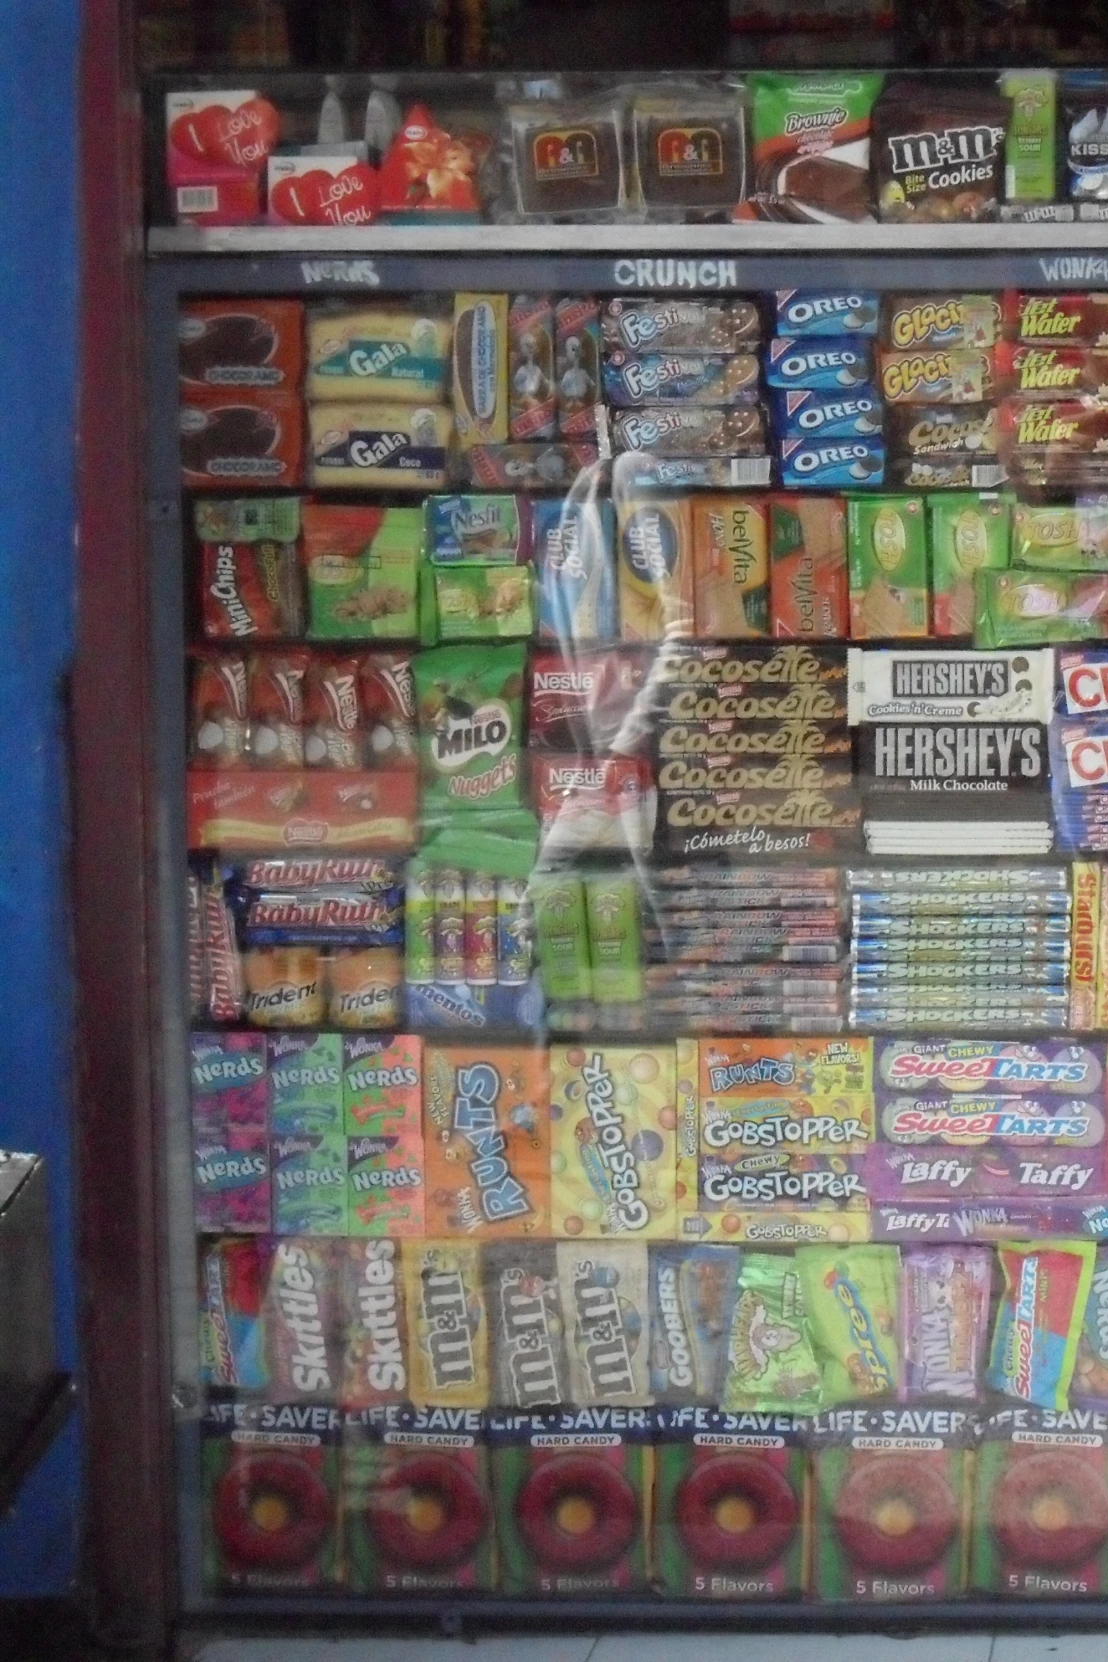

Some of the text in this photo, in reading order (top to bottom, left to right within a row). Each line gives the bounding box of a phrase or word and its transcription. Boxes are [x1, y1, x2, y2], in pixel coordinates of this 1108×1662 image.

[785, 107, 848, 136] Brownie
[905, 164, 993, 190] Bite Cookies
[906, 183, 926, 192] Size
[614, 260, 736, 288] CRUNCH
[787, 296, 863, 323] OREO
[1018, 312, 1080, 336] Wafer
[350, 342, 406, 376] Gala
[781, 352, 856, 376] OREO
[1020, 363, 1080, 389] Wafer
[799, 399, 872, 428] OREO
[1018, 418, 1079, 444] Wafer
[350, 432, 407, 468] Gala
[793, 445, 869, 472] OREO
[879, 513, 898, 567] TOSH
[1028, 520, 1081, 540] TOSH
[547, 527, 568, 571] CLUB
[629, 525, 648, 570] CLUB
[733, 509, 758, 585] belVita
[790, 557, 817, 632] belVita
[1009, 593, 1065, 611] TOSH
[896, 662, 1005, 695] HERSHEY'S
[669, 684, 836, 719] Cocosette
[435, 718, 508, 759] MILO
[659, 721, 826, 754] Cocosette
[875, 727, 1041, 777] HERSHEY'S
[448, 753, 518, 799] Nuggets
[658, 755, 825, 790] Cocosette
[910, 779, 1008, 791] Milk Chocolate
[667, 790, 834, 828] Cocosette
[765, 833, 810, 852] besos!
[890, 892, 1025, 905] SHOCKERS
[889, 921, 1024, 935] SHOCKERS
[887, 939, 1022, 950] SHOCKERS
[887, 963, 1022, 978] SHOCKERS
[250, 982, 317, 1011] Trident
[414, 985, 486, 1027] mentos
[887, 1009, 1022, 1022] SHOCKERS
[820, 1052, 860, 1065] FLAVORS!
[827, 1042, 848, 1053] NEW
[948, 1045, 994, 1057] CHEWY
[710, 1059, 796, 1092] RUNTS
[951, 1101, 997, 1113] CHEWY
[455, 1062, 531, 1221] RUNTS
[901, 1160, 1094, 1191] Laffy Taffy
[276, 1243, 331, 1392] Skittles
[359, 1240, 406, 1392] Skittles
[658, 1267, 693, 1388] GOOBERS
[390, 1435, 468, 1447] HARD CANDY
[537, 1434, 615, 1446] HARD CANDY
[700, 1435, 778, 1447] HARD CANDY
[858, 1438, 937, 1449] HARD CANDY
[695, 1577, 774, 1593] 5 Flavors
[856, 1581, 935, 1595] 5 Flavors
[1008, 1575, 1088, 1592] 5 Flavors
